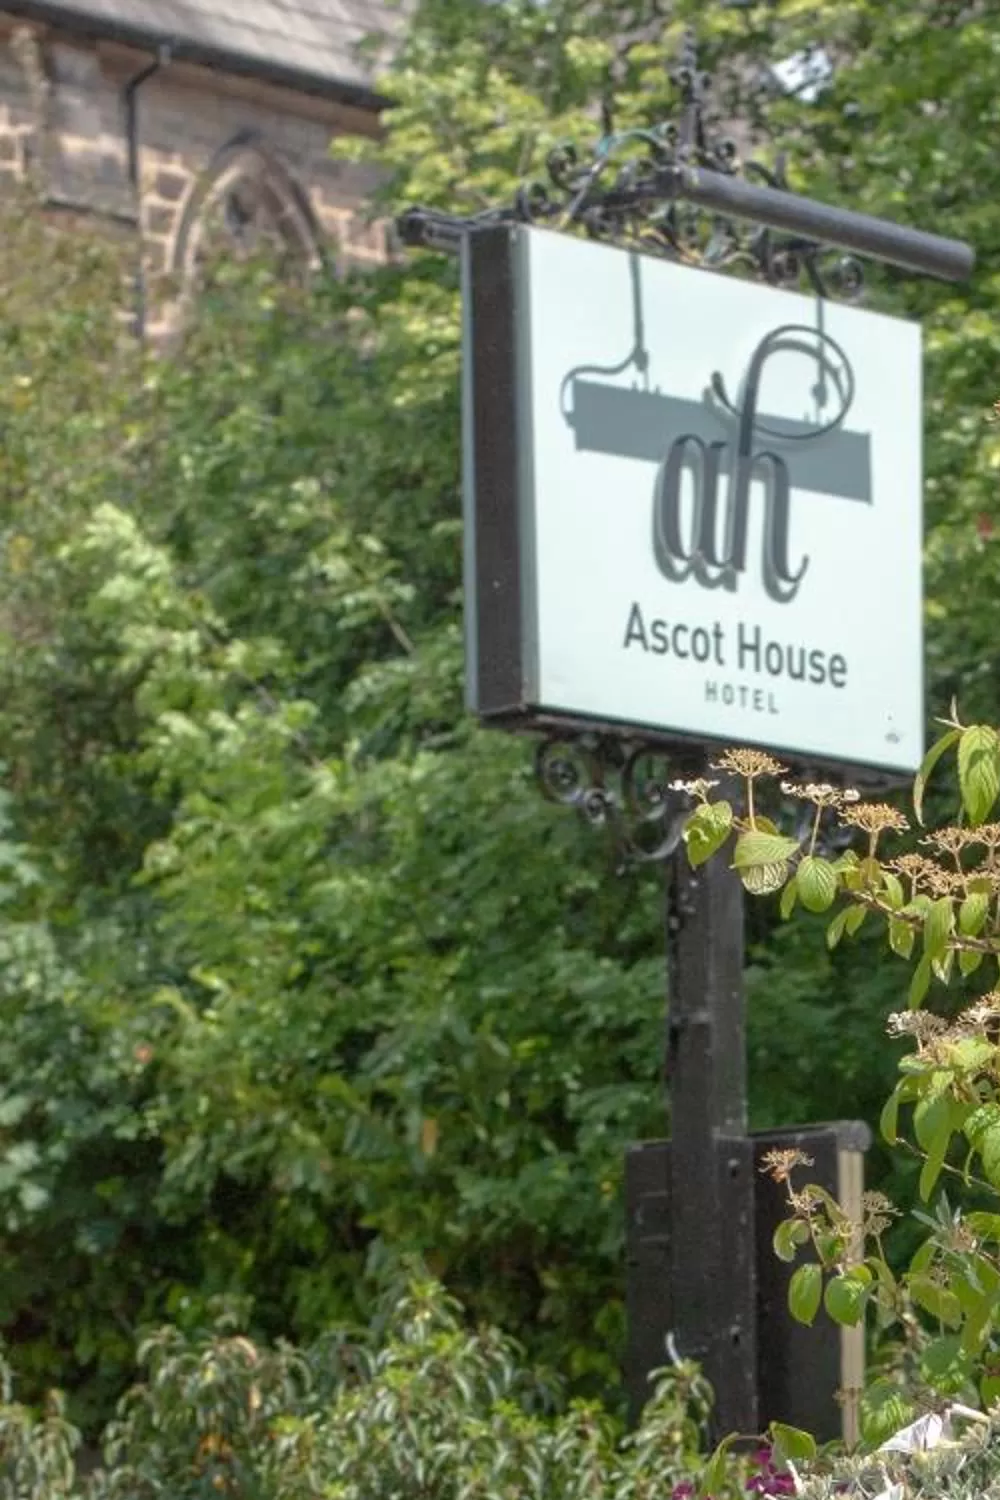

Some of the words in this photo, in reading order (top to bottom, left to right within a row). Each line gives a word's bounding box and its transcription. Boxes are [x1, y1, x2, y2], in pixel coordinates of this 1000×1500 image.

[623, 602, 726, 666] Ascot
[737, 621, 848, 688] House
[704, 679, 780, 715] HOTEL
